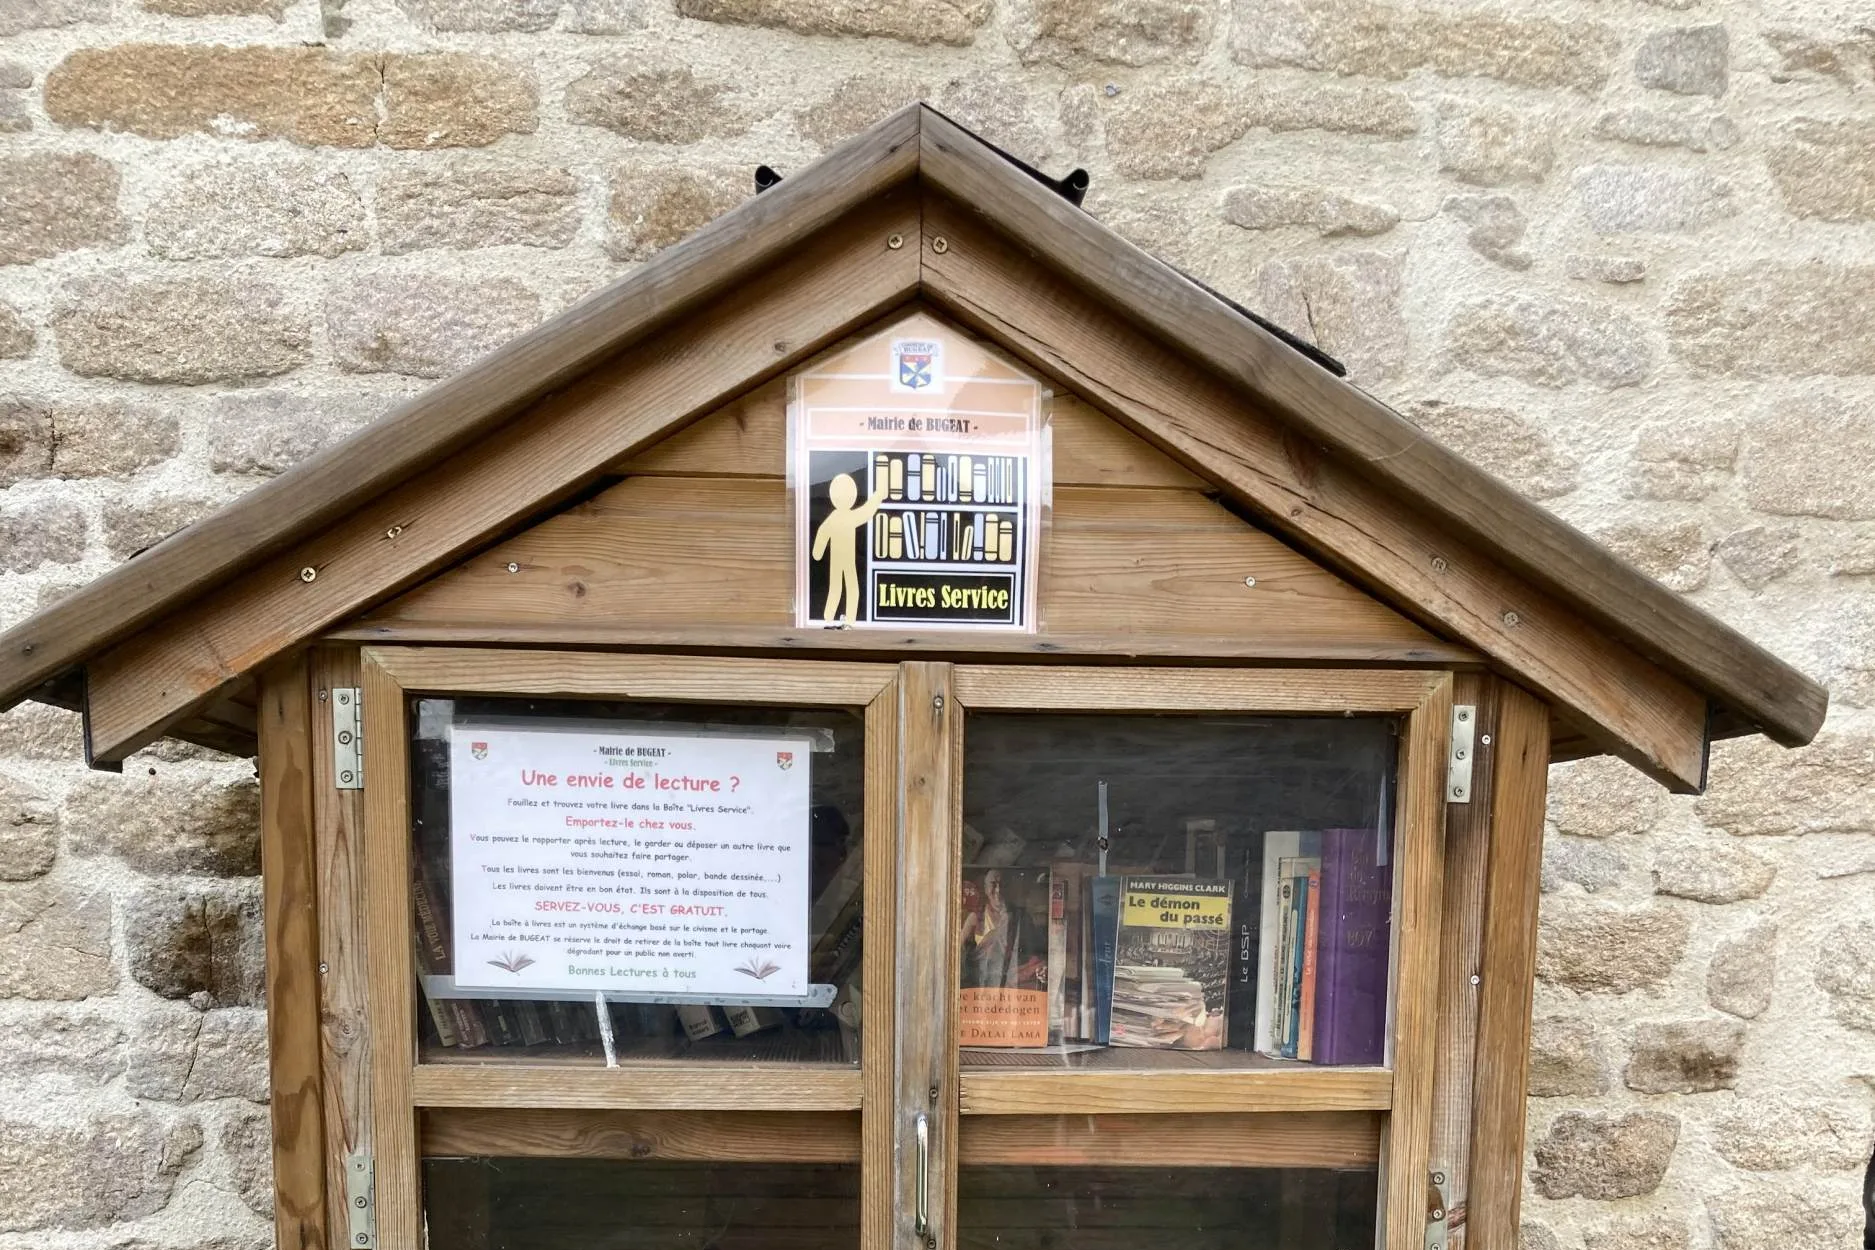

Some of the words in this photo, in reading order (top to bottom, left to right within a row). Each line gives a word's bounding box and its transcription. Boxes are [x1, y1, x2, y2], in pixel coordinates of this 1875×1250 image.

[868, 417, 904, 431] Mairie
[908, 418, 922, 431] de
[926, 418, 970, 433] BUGEAT
[879, 584, 935, 607] Livres
[941, 585, 1008, 609] Service
[599, 747, 622, 756] Mairie
[626, 748, 634, 756] de
[637, 748, 665, 757] BUGEAT
[630, 759, 653, 767] Service
[522, 769, 557, 786] Une
[567, 772, 614, 788] envie
[623, 773, 644, 789] de
[655, 773, 720, 791] lecture
[730, 776, 739, 792] ?
[508, 799, 537, 807] Fouillez
[587, 801, 607, 809] votre
[611, 801, 628, 809] livre
[632, 802, 649, 810] dans
[663, 803, 684, 811] Boîte
[688, 804, 714, 813] "Livres
[566, 816, 634, 828] Emportez-le
[640, 819, 664, 829] chez
[669, 821, 696, 830] vous.
[470, 834, 488, 842] Vous
[493, 836, 518, 844] pouvez
[522, 835, 529, 843] le
[600, 839, 630, 847] lecture,
[644, 840, 671, 849] garder
[687, 841, 717, 850] déposer
[757, 843, 774, 851] livre
[591, 851, 627, 859] souhaitez
[632, 852, 651, 860] faire
[482, 865, 499, 873] Tous
[503, 865, 514, 873] les
[518, 866, 539, 874] livres
[563, 867, 573, 875] les
[577, 868, 614, 876] bienvenus
[617, 869, 644, 878] (essai,
[647, 872, 673, 880] roman,
[704, 872, 727, 880] bande
[493, 882, 506, 890] Les
[535, 884, 562, 892] doivent
[599, 885, 613, 893] bon
[616, 886, 636, 894] état.
[640, 887, 650, 895] Ils
[674, 887, 679, 895] à
[693, 889, 734, 898] disposition
[1158, 883, 1193, 891] HIGGINS
[535, 901, 624, 914] SERVEZ-VOUS,
[630, 904, 665, 914] C'EST
[670, 905, 727, 916] GRATUIT.
[1129, 896, 1145, 907] Le
[1151, 896, 1200, 910] démon
[1160, 911, 1178, 922] du
[1184, 913, 1223, 925] passé
[503, 919, 521, 927] boîte
[580, 922, 608, 930] système
[612, 923, 647, 932] d'échange
[693, 925, 717, 933] civisme
[741, 941, 771, 949] choquant
[1241, 924, 1249, 960] BSP
[567, 948, 603, 956] dégradant
[635, 950, 655, 958] public
[568, 965, 605, 975] Bonnes
[611, 967, 657, 977] Lectures
[663, 968, 669, 978] à
[673, 969, 696, 978] tous
[1241, 967, 1248, 983] Le
[973, 1004, 1039, 1015] mededogen
